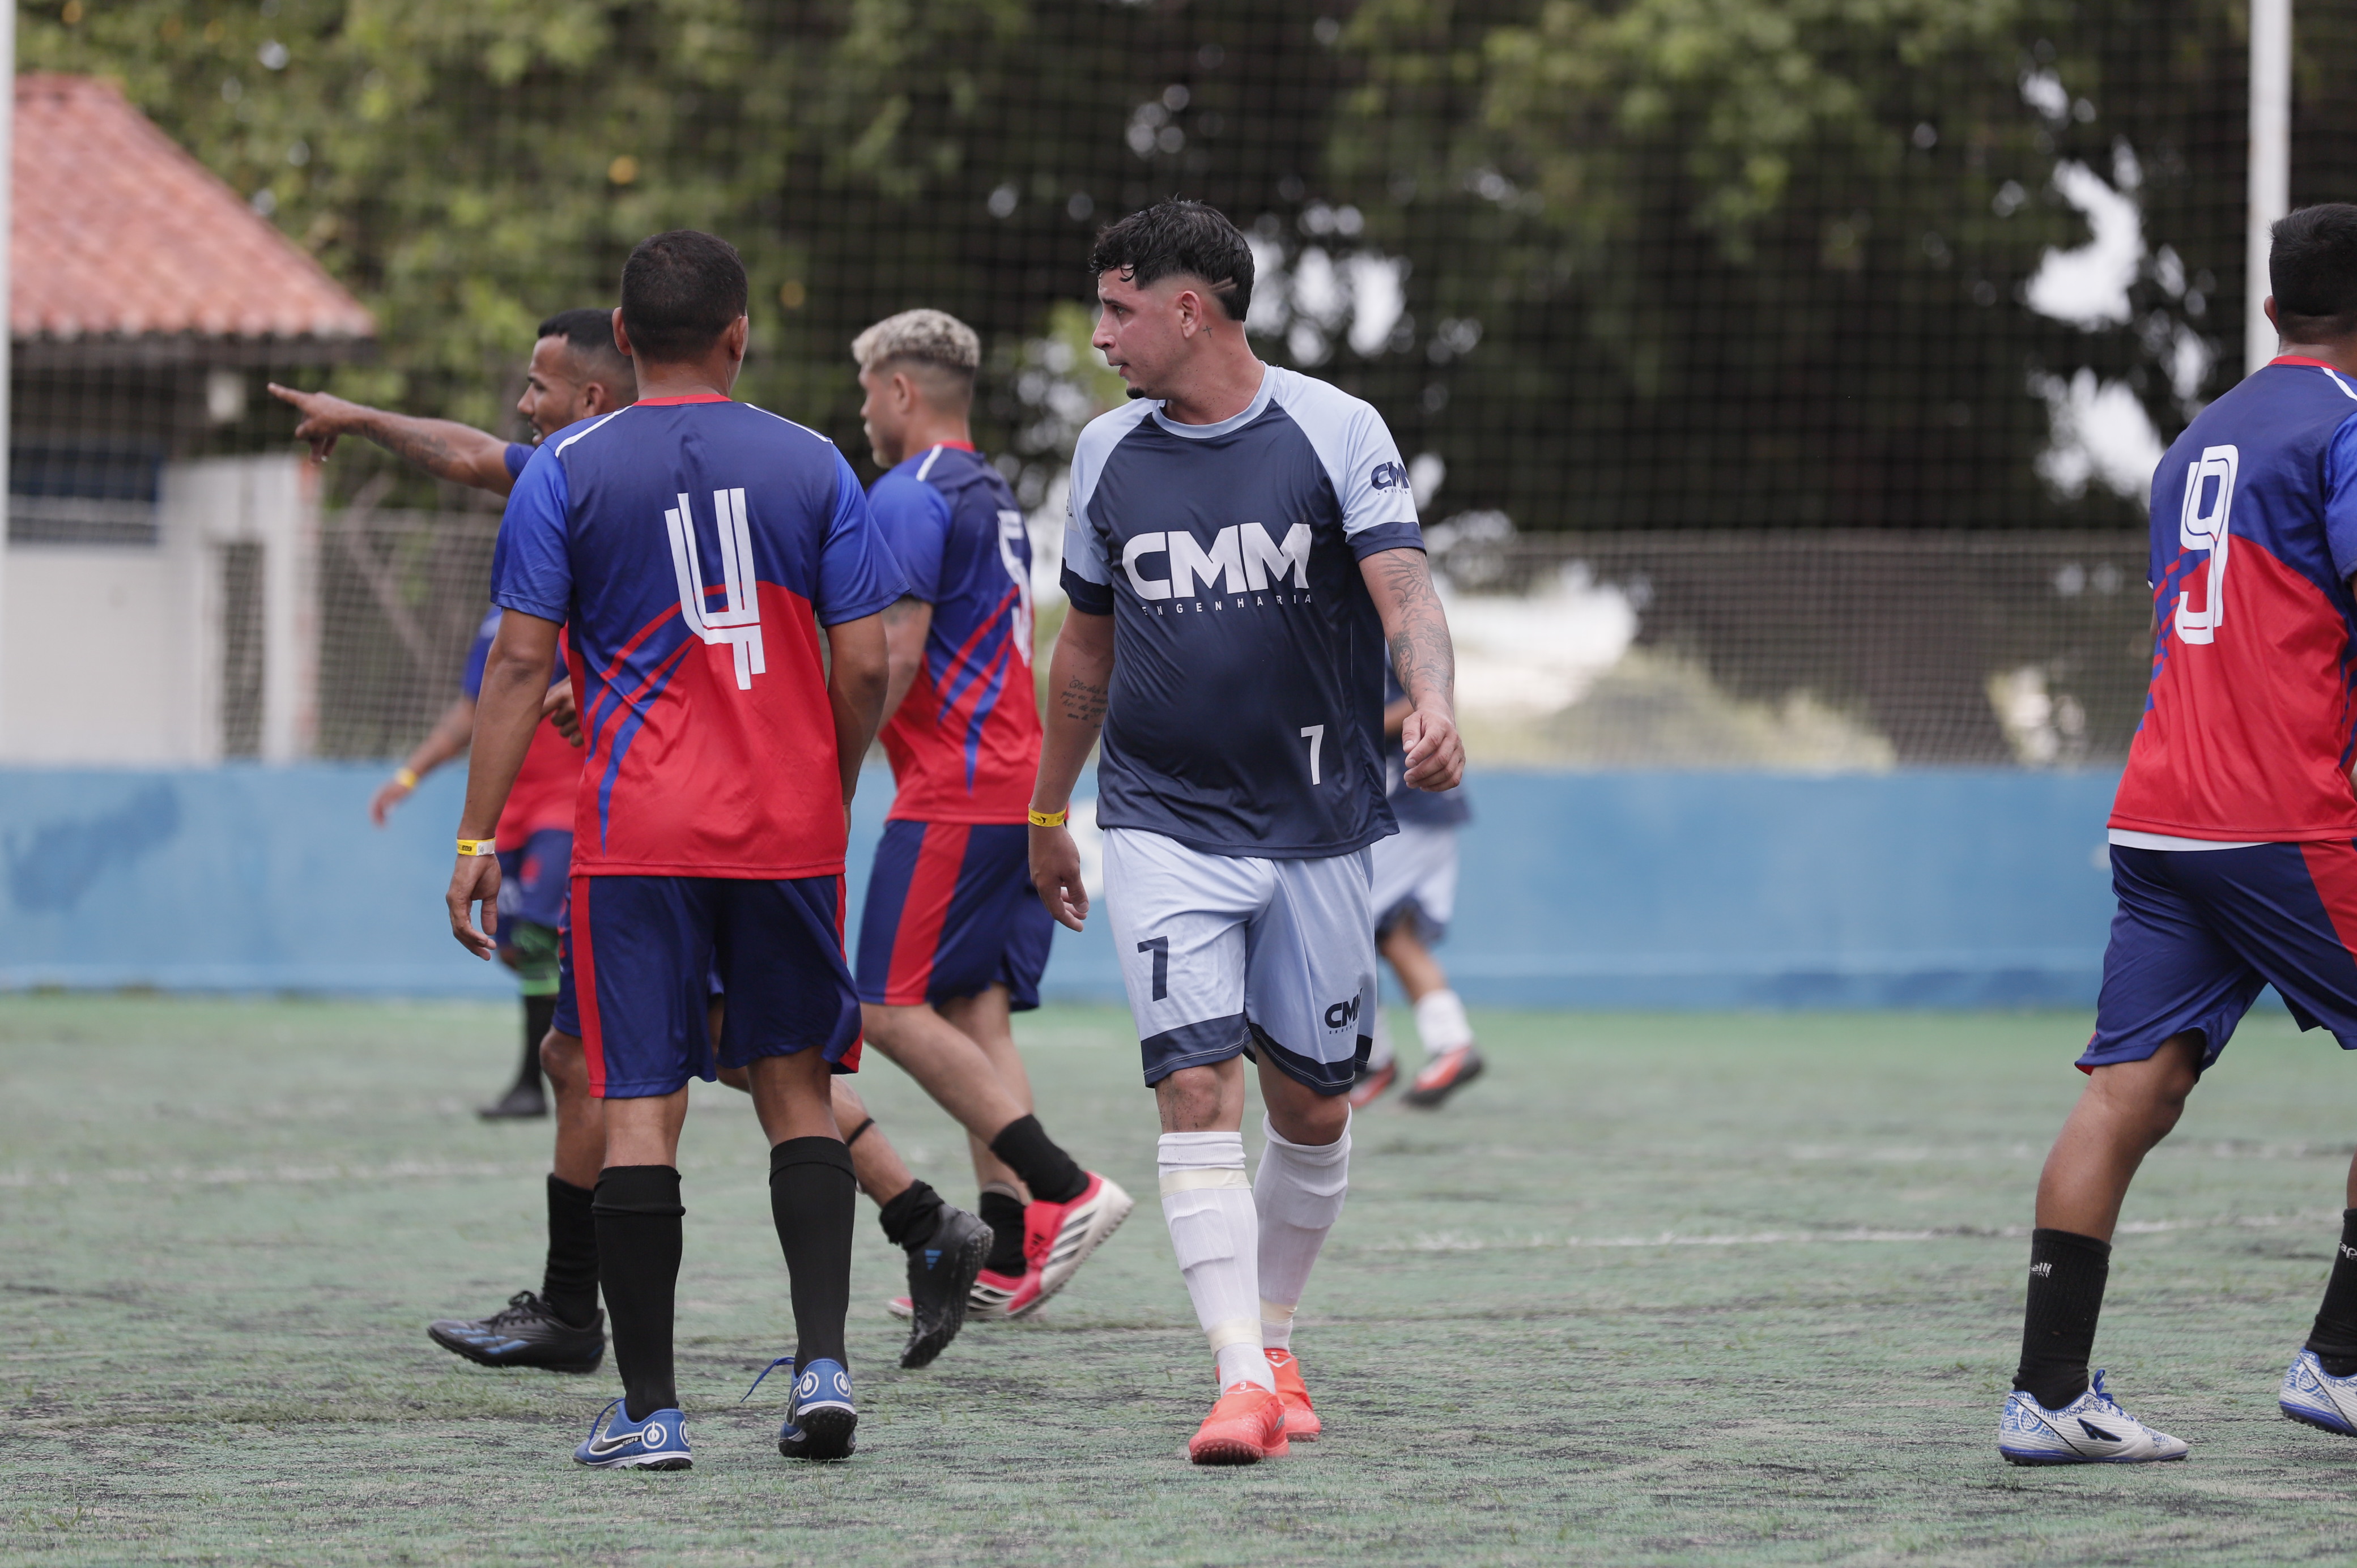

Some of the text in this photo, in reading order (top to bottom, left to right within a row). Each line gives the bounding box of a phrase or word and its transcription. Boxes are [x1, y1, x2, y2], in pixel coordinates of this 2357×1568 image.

[1122, 522, 1312, 601] CMM
[2175, 444, 2239, 645] 9
[665, 488, 765, 690] 4
[997, 510, 1032, 668] 5
[1141, 594, 1312, 615] ENGENHARIA
[1301, 725, 1324, 786] 7
[1137, 936, 1169, 1002] 7
[2339, 1241, 2357, 1259] ap
